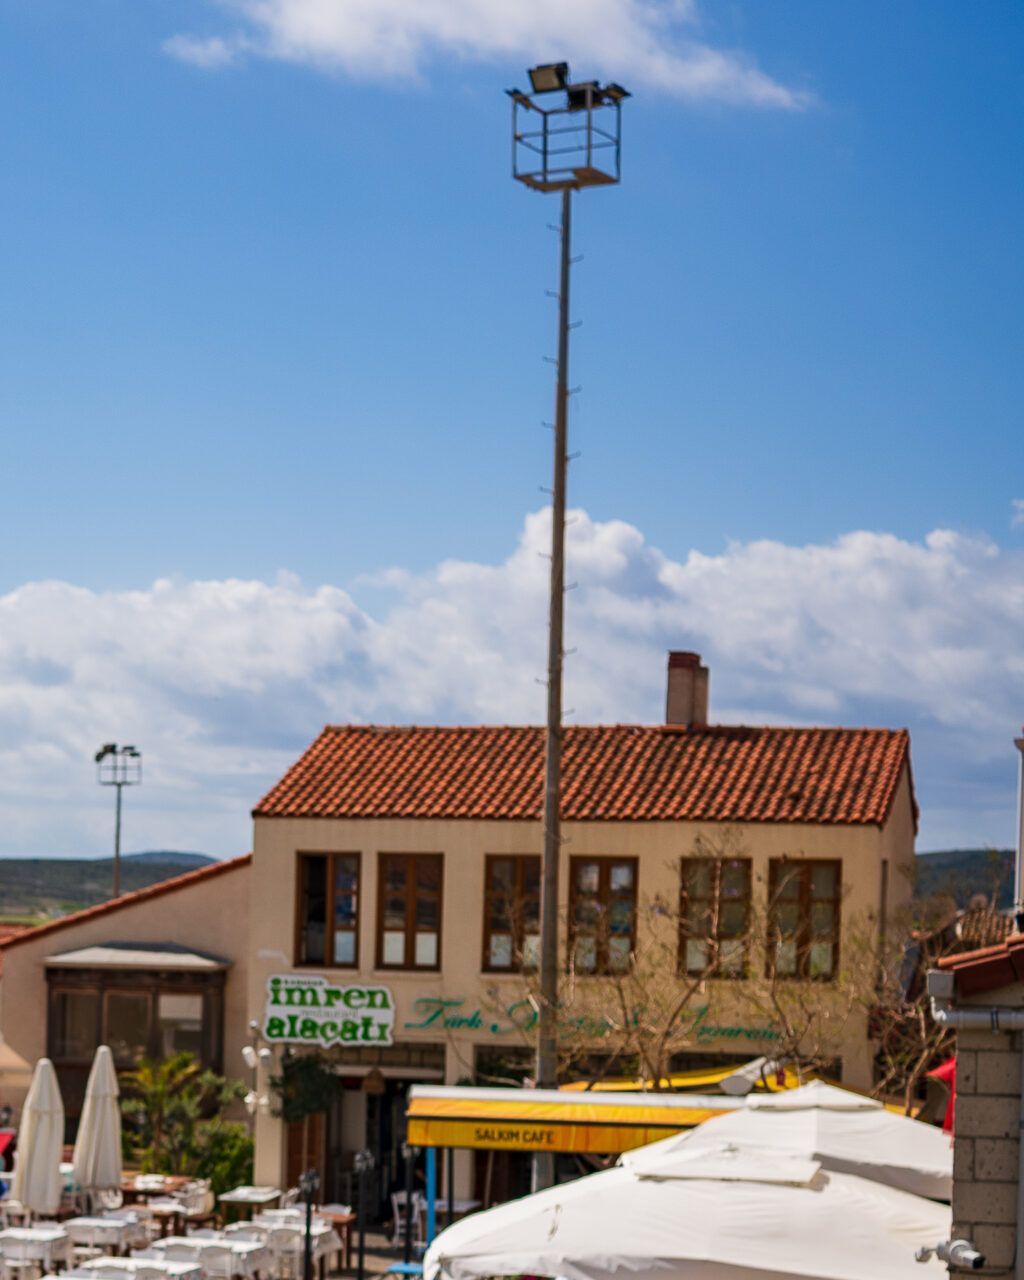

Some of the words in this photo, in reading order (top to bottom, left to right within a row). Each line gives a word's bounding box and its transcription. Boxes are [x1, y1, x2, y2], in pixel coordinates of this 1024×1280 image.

[271, 977, 391, 1009] imren
[266, 1014, 389, 1044] alaçatı
[522, 1129, 554, 1144] CAFE
